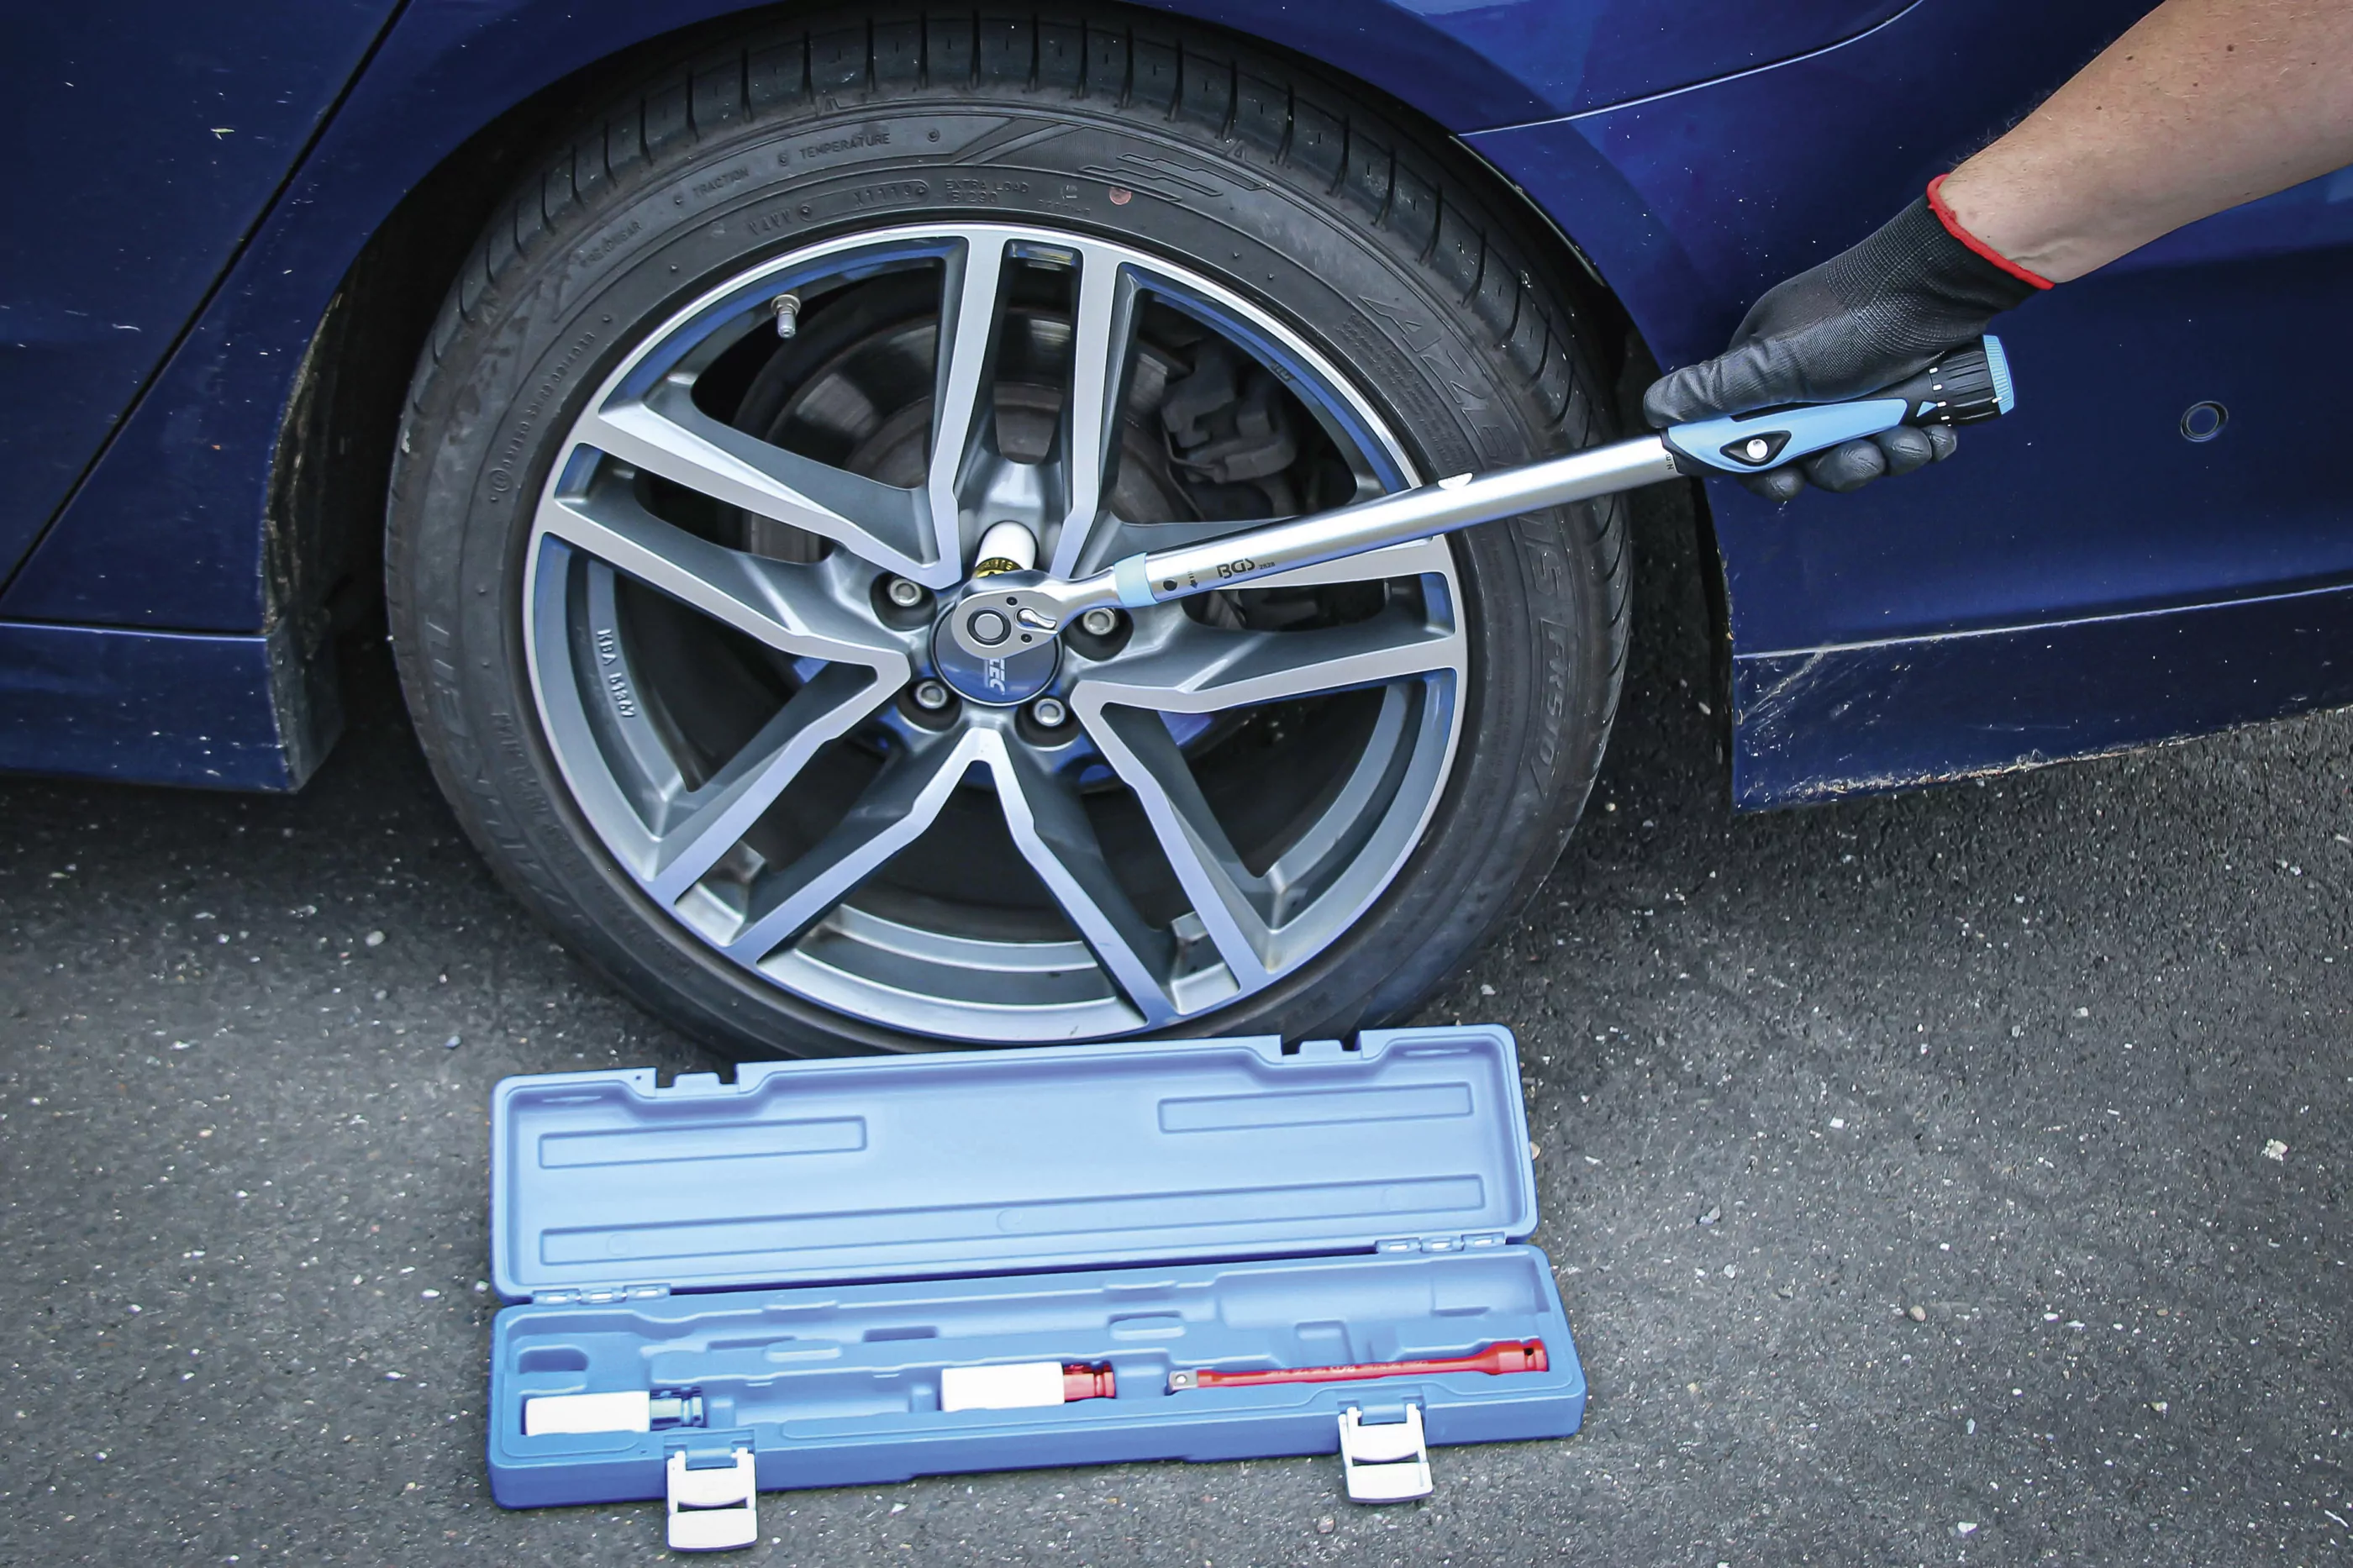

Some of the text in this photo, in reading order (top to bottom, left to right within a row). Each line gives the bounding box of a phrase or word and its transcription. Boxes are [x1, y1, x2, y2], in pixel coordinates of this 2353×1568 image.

[799, 133, 891, 160] TEMPERATURE
[692, 167, 750, 199] TRACTION
[944, 178, 1029, 193] EXTRA LOAD
[1215, 557, 1255, 580] BGS
[596, 628, 618, 666] KBA
